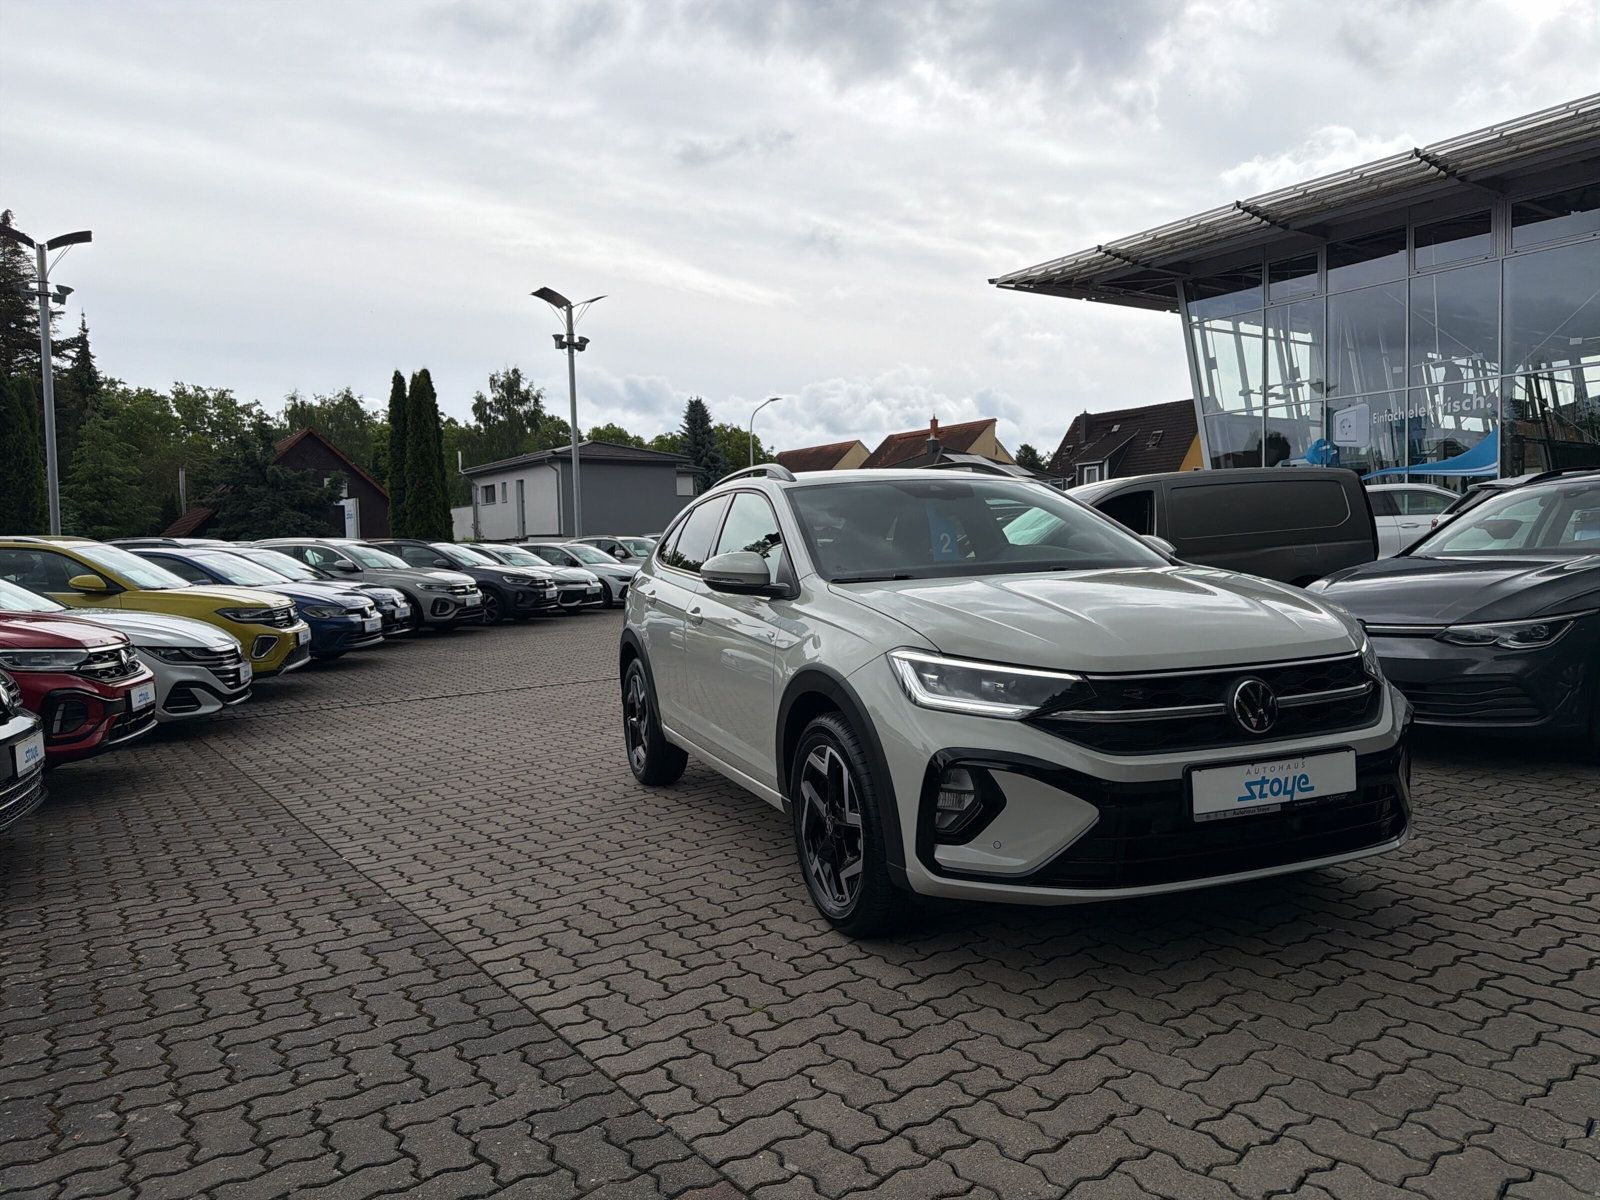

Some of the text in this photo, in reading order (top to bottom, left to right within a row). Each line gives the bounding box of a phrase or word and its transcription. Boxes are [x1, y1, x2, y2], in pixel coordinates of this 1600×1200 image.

[1372, 406, 1405, 424] Einfach
[940, 532, 952, 553] 2
[1246, 761, 1306, 776] AUTOHAUS
